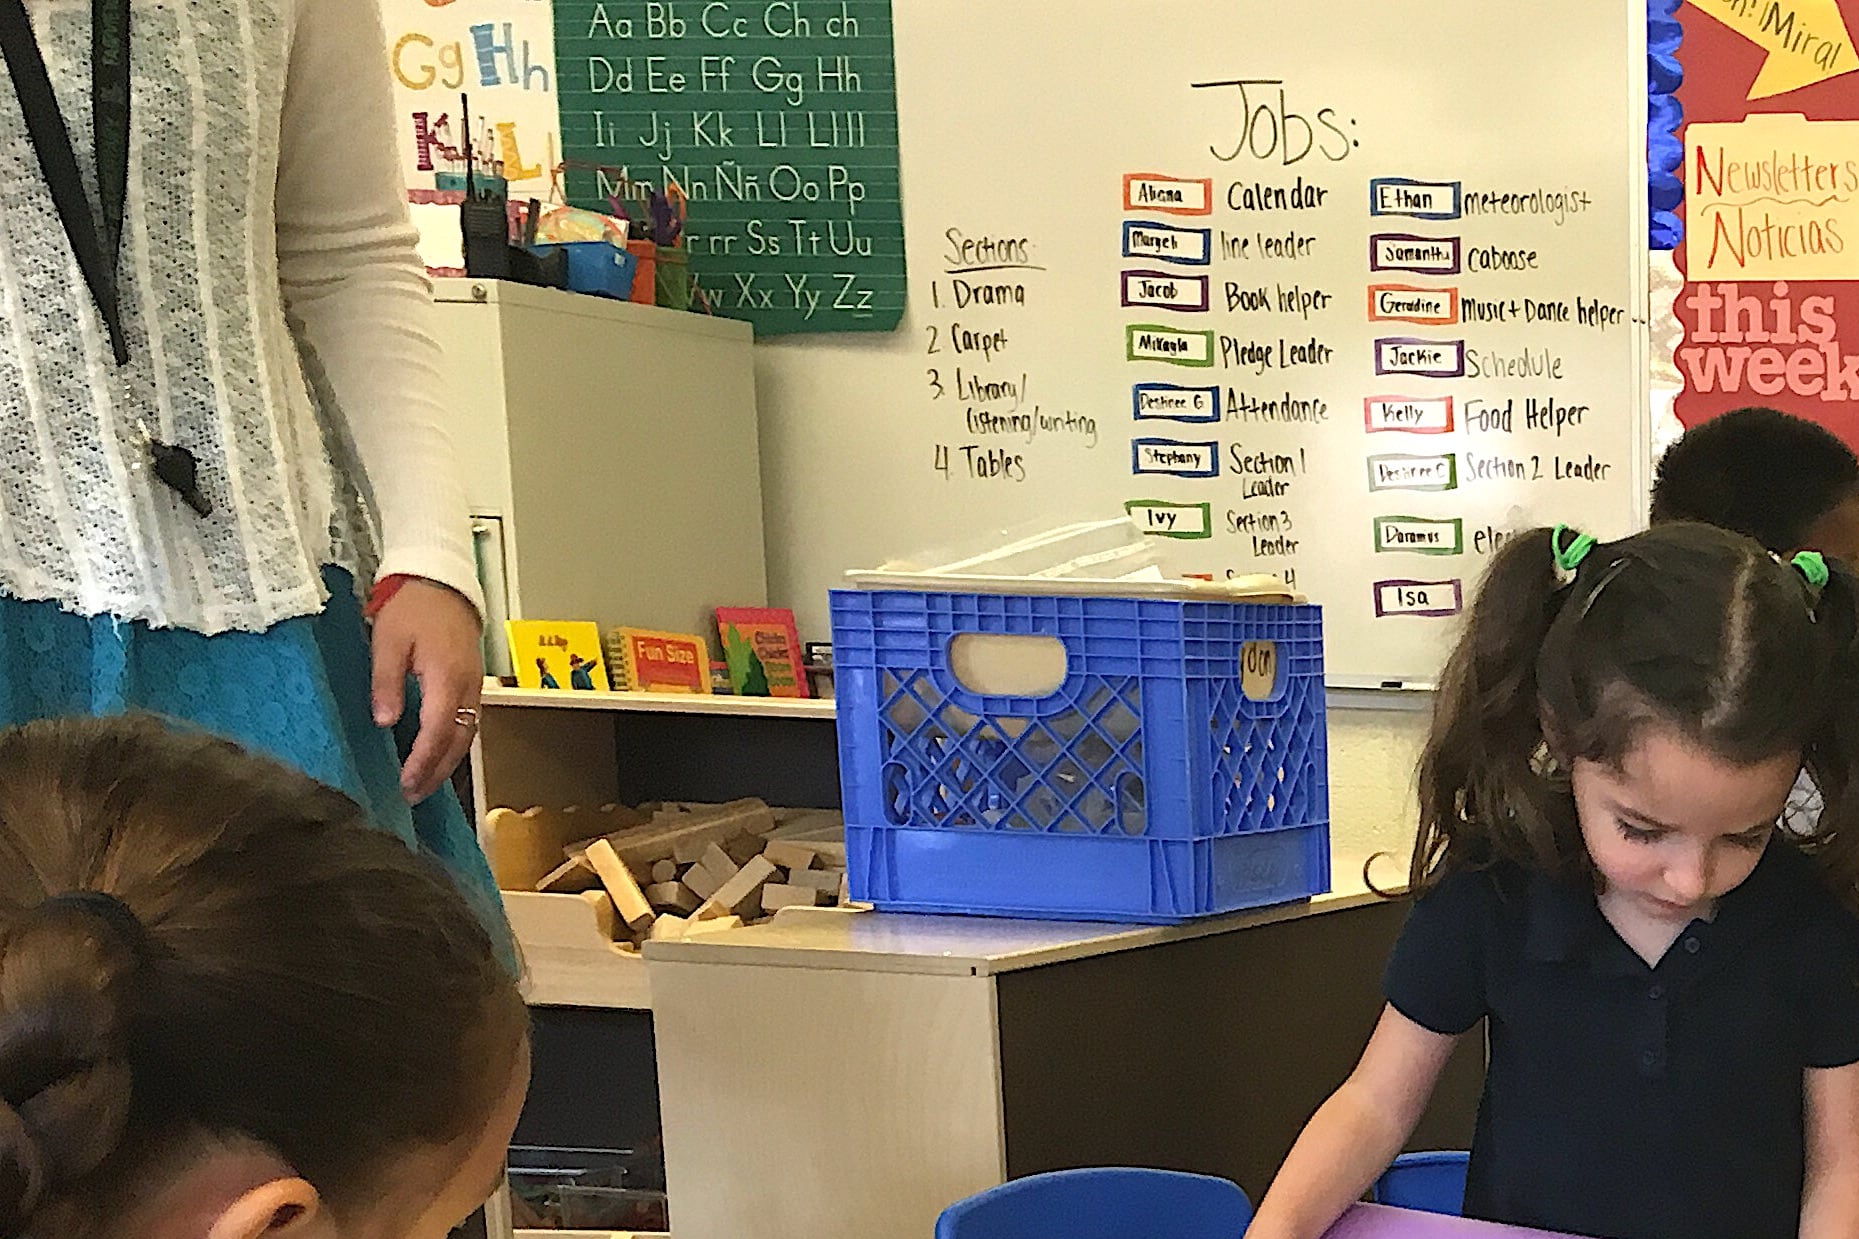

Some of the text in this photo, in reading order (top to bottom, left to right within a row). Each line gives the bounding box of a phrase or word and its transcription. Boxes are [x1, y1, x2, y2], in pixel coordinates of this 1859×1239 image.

[588, 2, 859, 39] Aa Bb Cc Ch ch
[588, 56, 862, 106] Dd Ee Ff Gg Hh
[593, 111, 616, 147] Ii
[638, 111, 671, 162] Jj
[693, 111, 734, 148] Kk
[1190, 79, 1360, 165] Jobs:
[662, 165, 708, 201] Nn
[715, 161, 761, 201] Ññ
[769, 165, 821, 202] Oo
[828, 165, 866, 216] Pp
[1695, 145, 1859, 198] Newsletters
[1227, 176, 1329, 212] Calendar
[1379, 186, 1433, 210] Ethan
[1463, 189, 1592, 226] meteorologist
[746, 220, 780, 255] Ss
[788, 220, 820, 256] Tt
[827, 220, 872, 256] Uu
[944, 227, 1029, 266] Sections
[1256, 230, 1317, 260] leader
[1706, 206, 1845, 269] Noticias
[734, 273, 774, 309] Xx
[784, 273, 821, 320] Yy
[832, 274, 873, 310] Zz
[953, 279, 1025, 309] Drama
[1138, 279, 1178, 300] Jacob
[1277, 283, 1333, 321] helper
[1685, 281, 1838, 344] this
[951, 322, 1009, 363] Carpet
[1220, 335, 1334, 376] Pledge Leader
[1465, 347, 1564, 380] Schedule
[1225, 387, 1331, 425] Attendance
[1382, 402, 1424, 425] Kelly
[1463, 397, 1590, 437] Food Helper
[959, 444, 1027, 482] Tables
[1229, 442, 1297, 477] Section
[1555, 454, 1612, 482] Leader
[1147, 508, 1178, 531] Ivy
[1396, 588, 1430, 608] Isa
[637, 640, 695, 665] Fun Size
